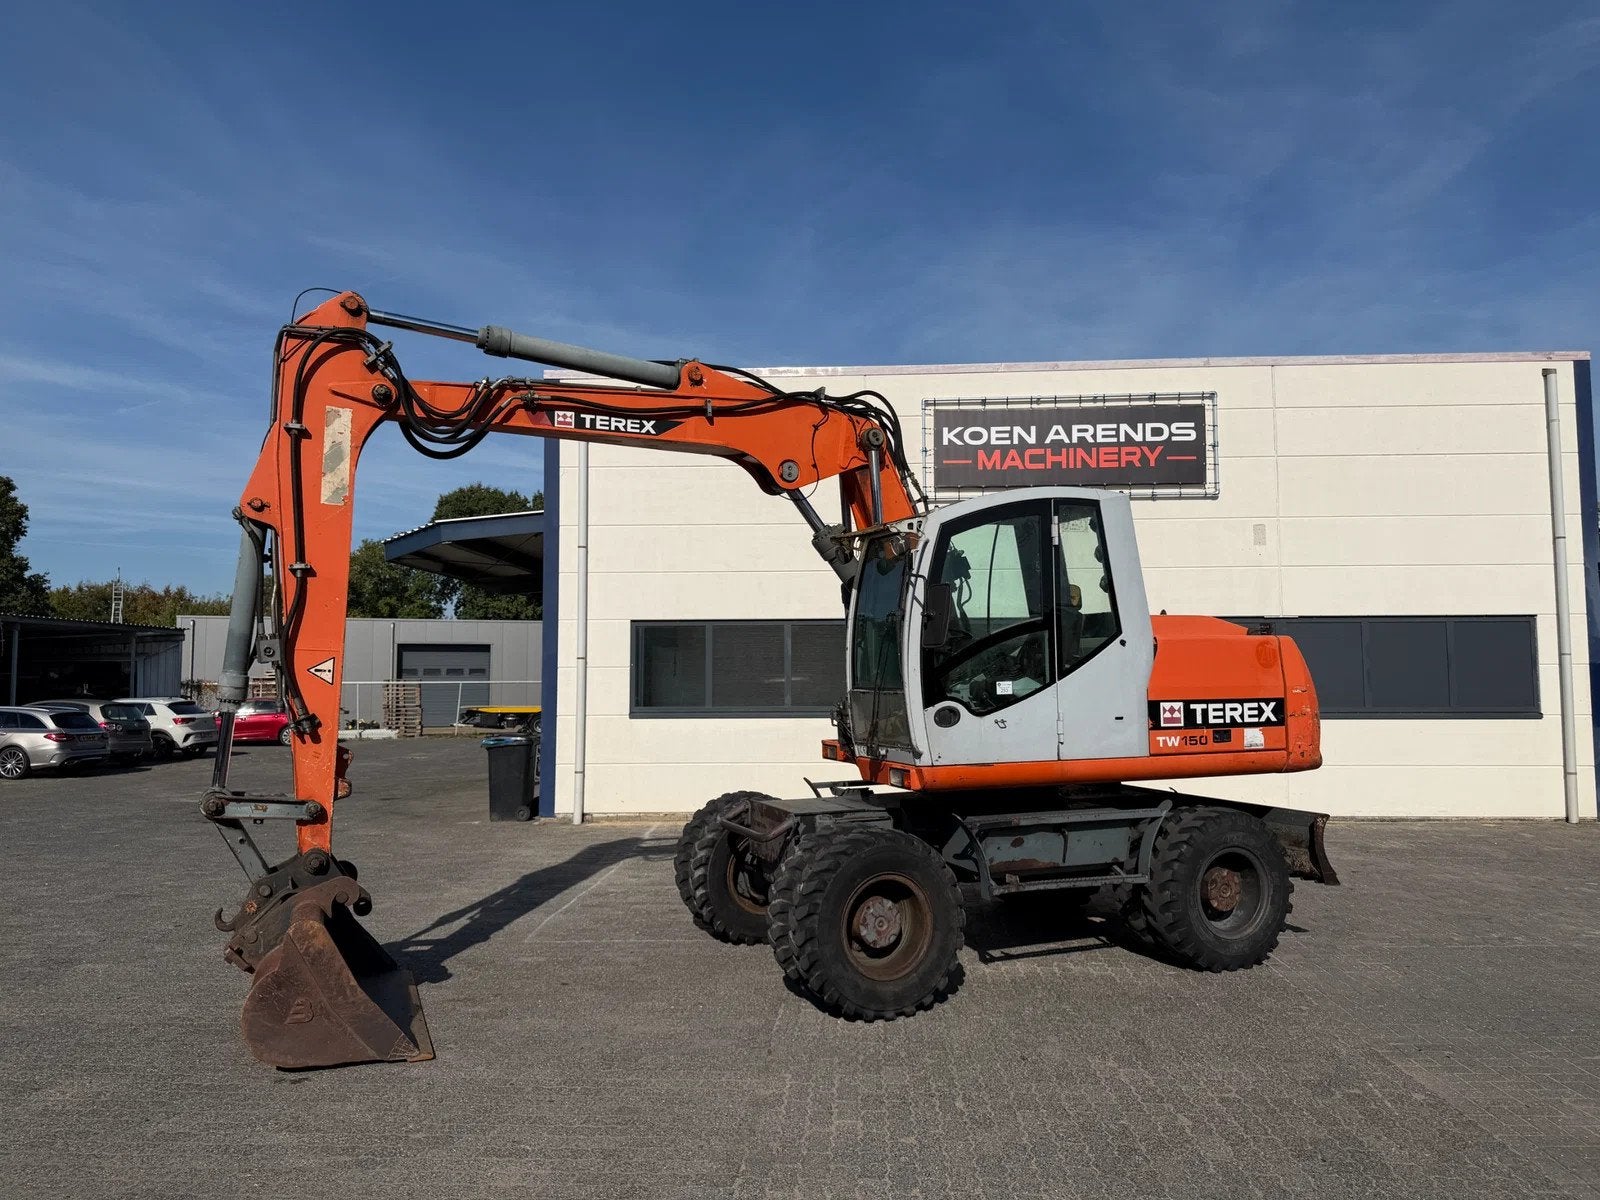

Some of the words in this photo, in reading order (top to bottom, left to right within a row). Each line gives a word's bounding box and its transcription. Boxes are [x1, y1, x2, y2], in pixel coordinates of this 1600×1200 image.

[580, 414, 657, 434] TEREX
[942, 426, 1037, 446] KOEN
[1044, 422, 1197, 444] ARENDS
[977, 446, 1164, 470] MACHINERY
[1190, 702, 1278, 724] TEREX
